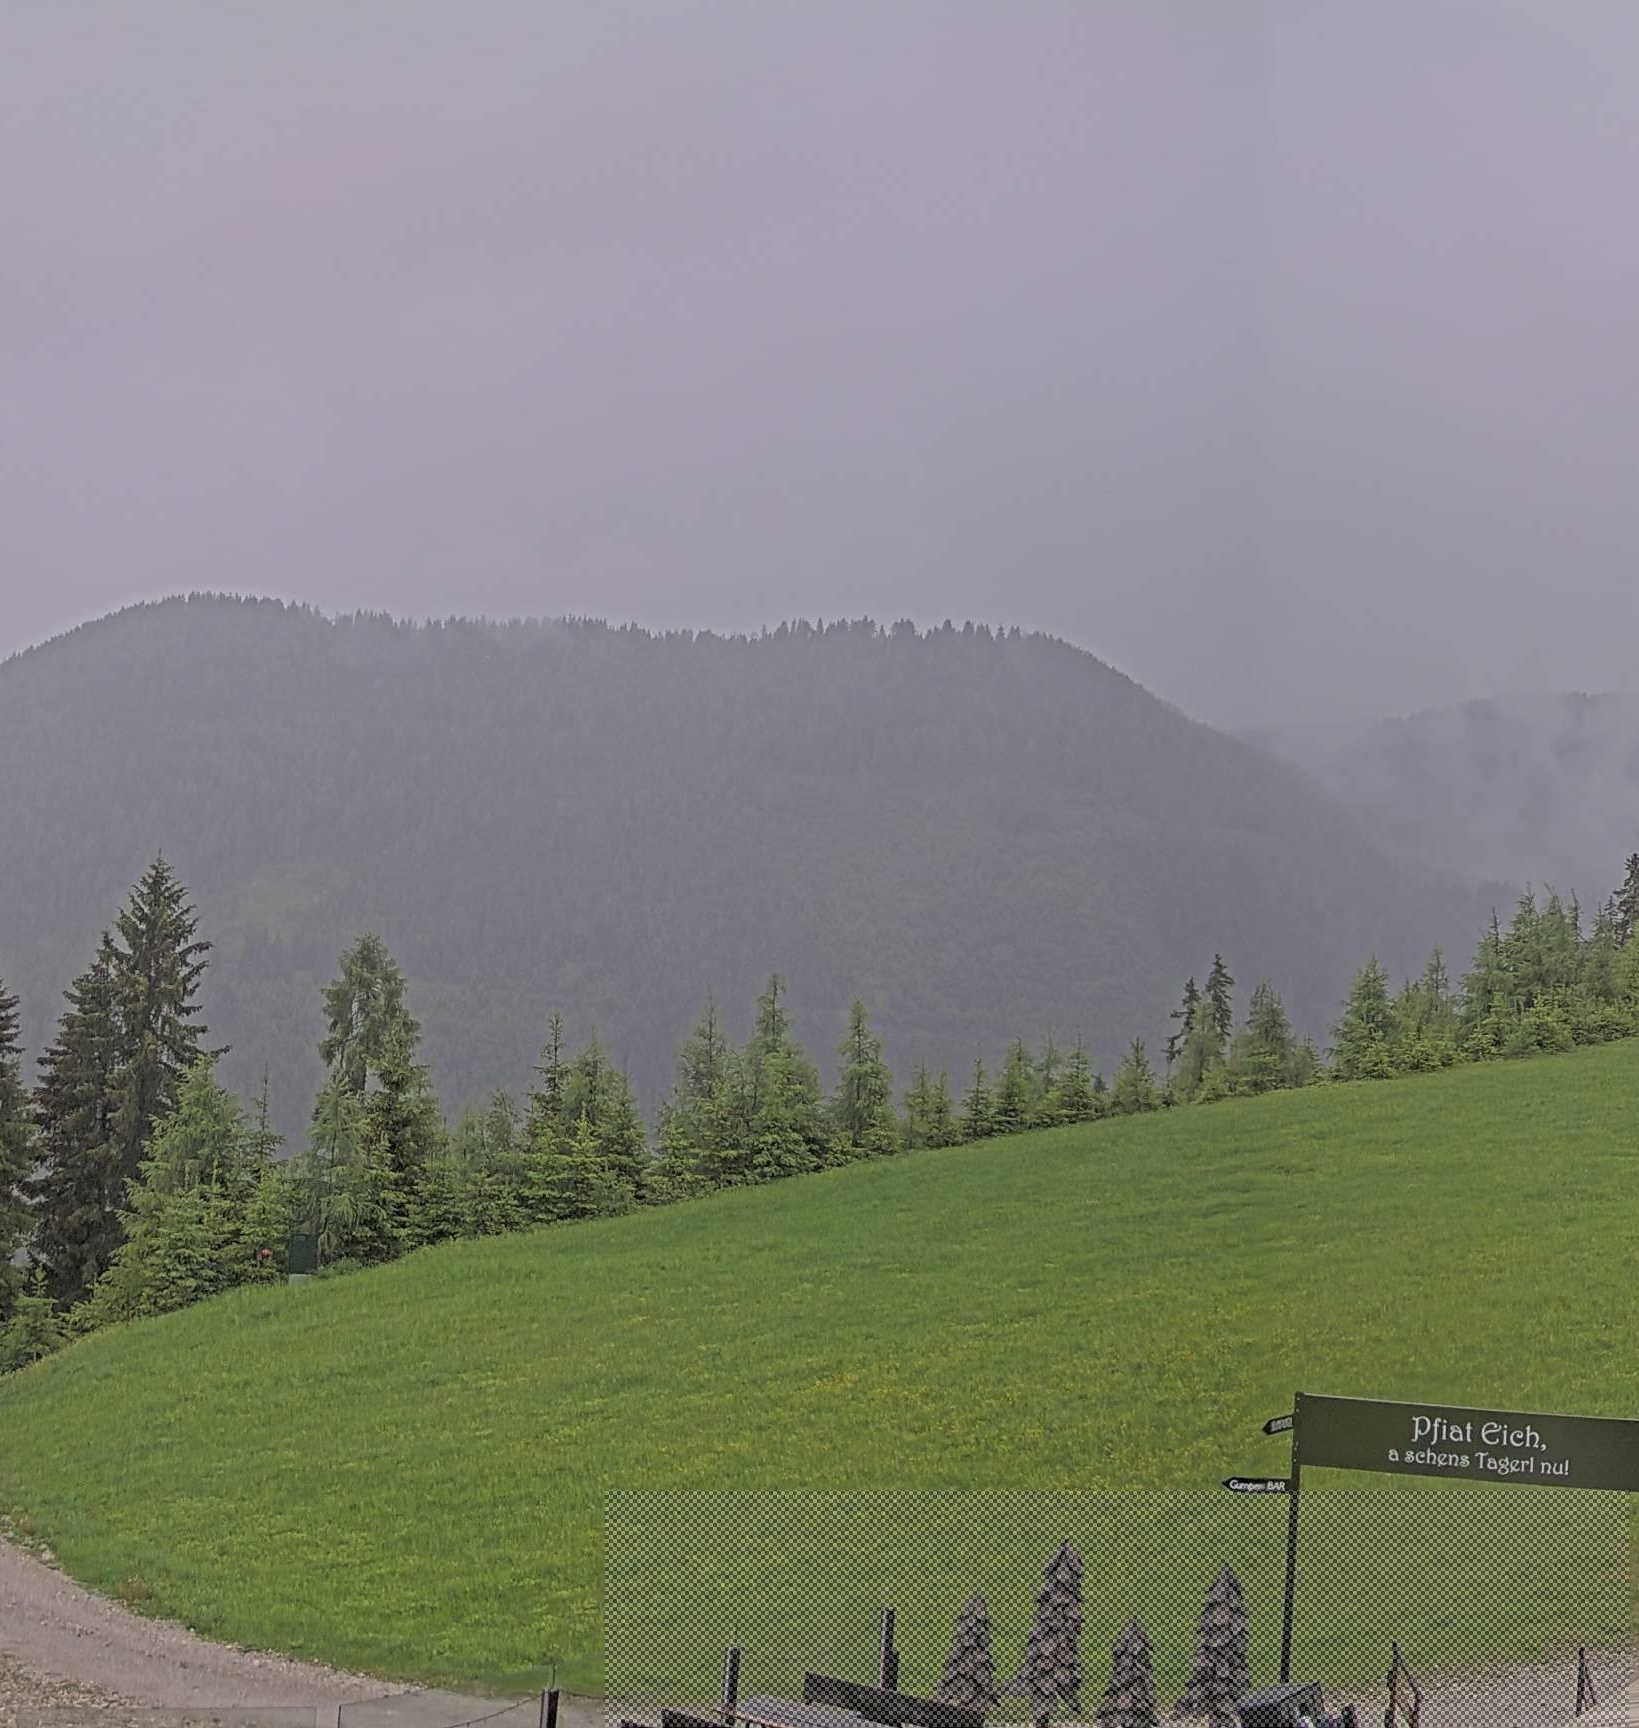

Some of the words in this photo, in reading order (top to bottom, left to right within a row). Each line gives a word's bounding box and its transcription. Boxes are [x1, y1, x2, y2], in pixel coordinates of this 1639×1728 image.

[1411, 1416, 1472, 1444] Pfiat
[1481, 1422, 1547, 1451] Eich,
[1388, 1449, 1399, 1461] a
[1404, 1448, 1470, 1467] schens
[1475, 1452, 1534, 1475] Tagerl
[1541, 1460, 1569, 1475] nu!
[1267, 1481, 1285, 1491] BAR
